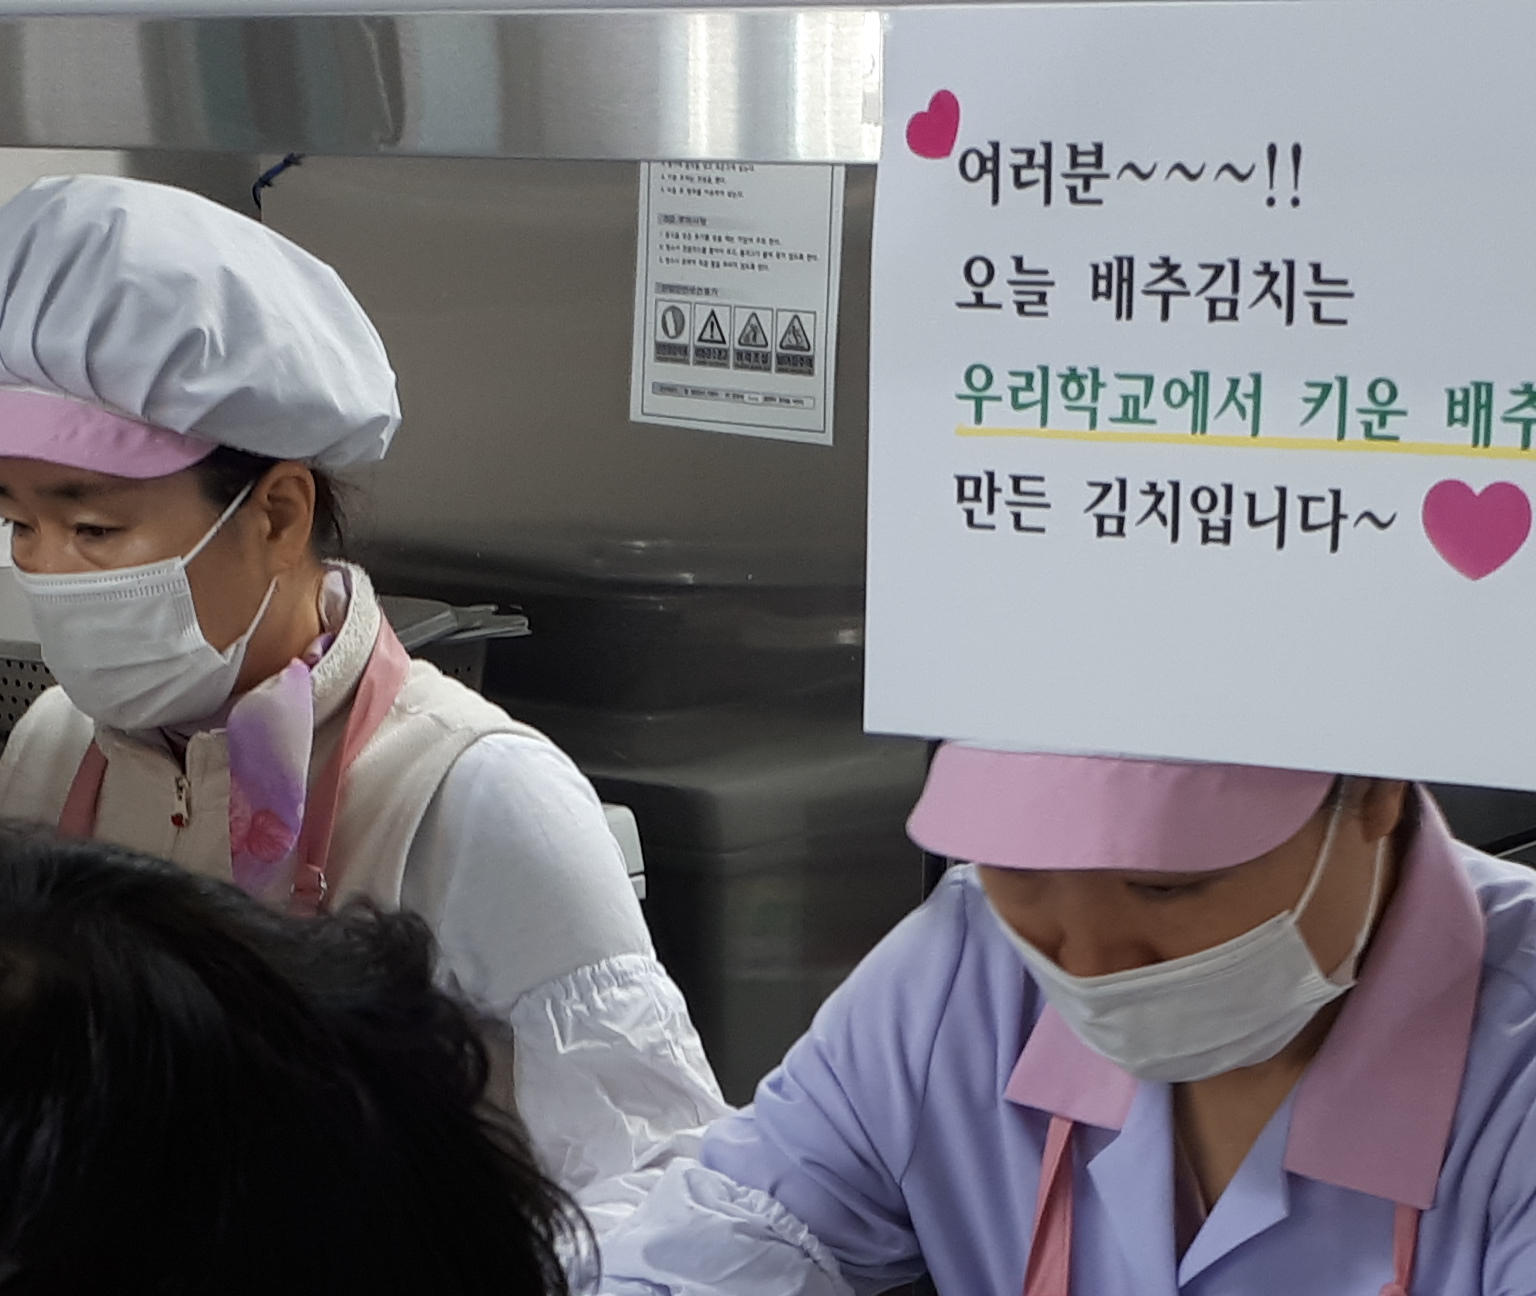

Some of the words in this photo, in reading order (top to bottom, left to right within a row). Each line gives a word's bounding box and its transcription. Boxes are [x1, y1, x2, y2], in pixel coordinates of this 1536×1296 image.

[955, 255, 1057, 318] 오늘
[1090, 255, 1356, 327] 배추김치는
[956, 363, 1264, 438] 우리학교에서
[1303, 375, 1409, 443] 키운
[954, 470, 1053, 534] 만든
[1085, 477, 1399, 555] 김치입니다~
